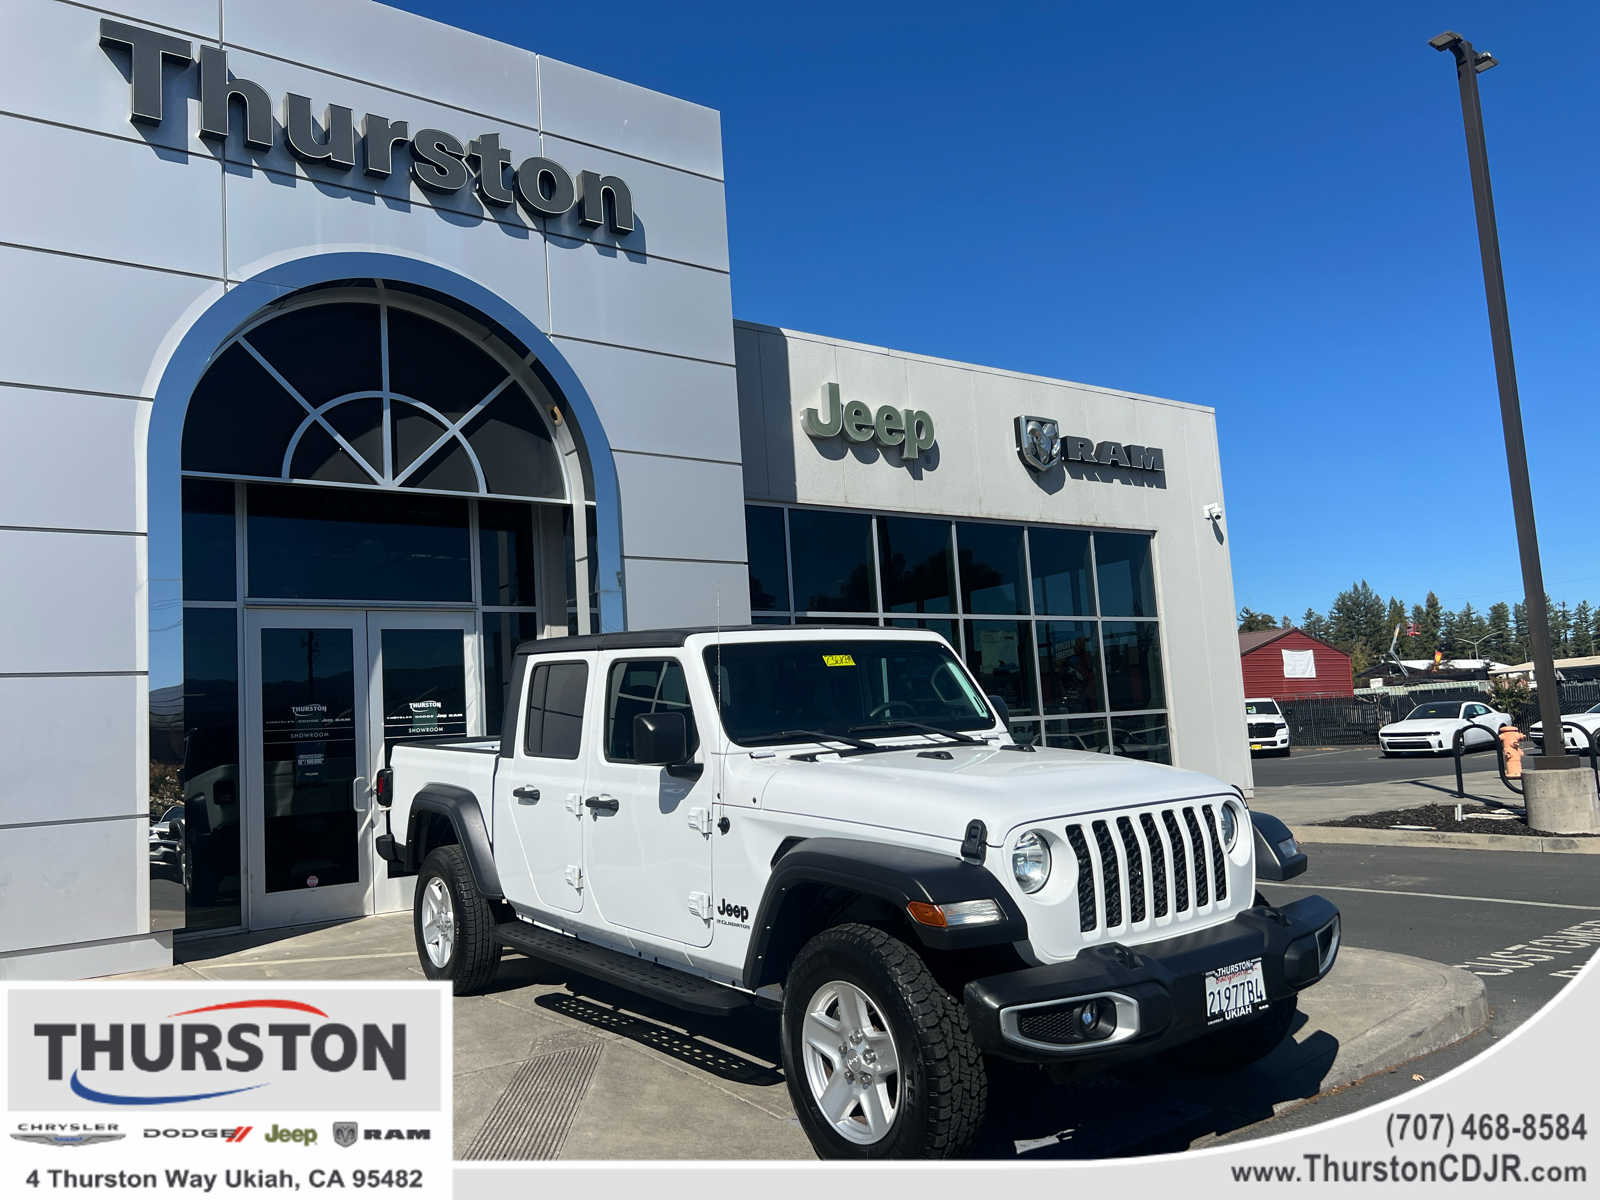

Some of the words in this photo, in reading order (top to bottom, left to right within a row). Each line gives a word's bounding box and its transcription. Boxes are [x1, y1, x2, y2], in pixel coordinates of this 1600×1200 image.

[100, 18, 635, 235] Thurston
[801, 382, 935, 460] Jeep
[1062, 435, 1165, 471] RAM
[409, 701, 442, 709] THURSTON
[717, 898, 749, 922] Jeep
[1216, 960, 1251, 976] THURSTON
[1208, 978, 1263, 1015] 21977B4
[1225, 1004, 1252, 1020] UKIAH
